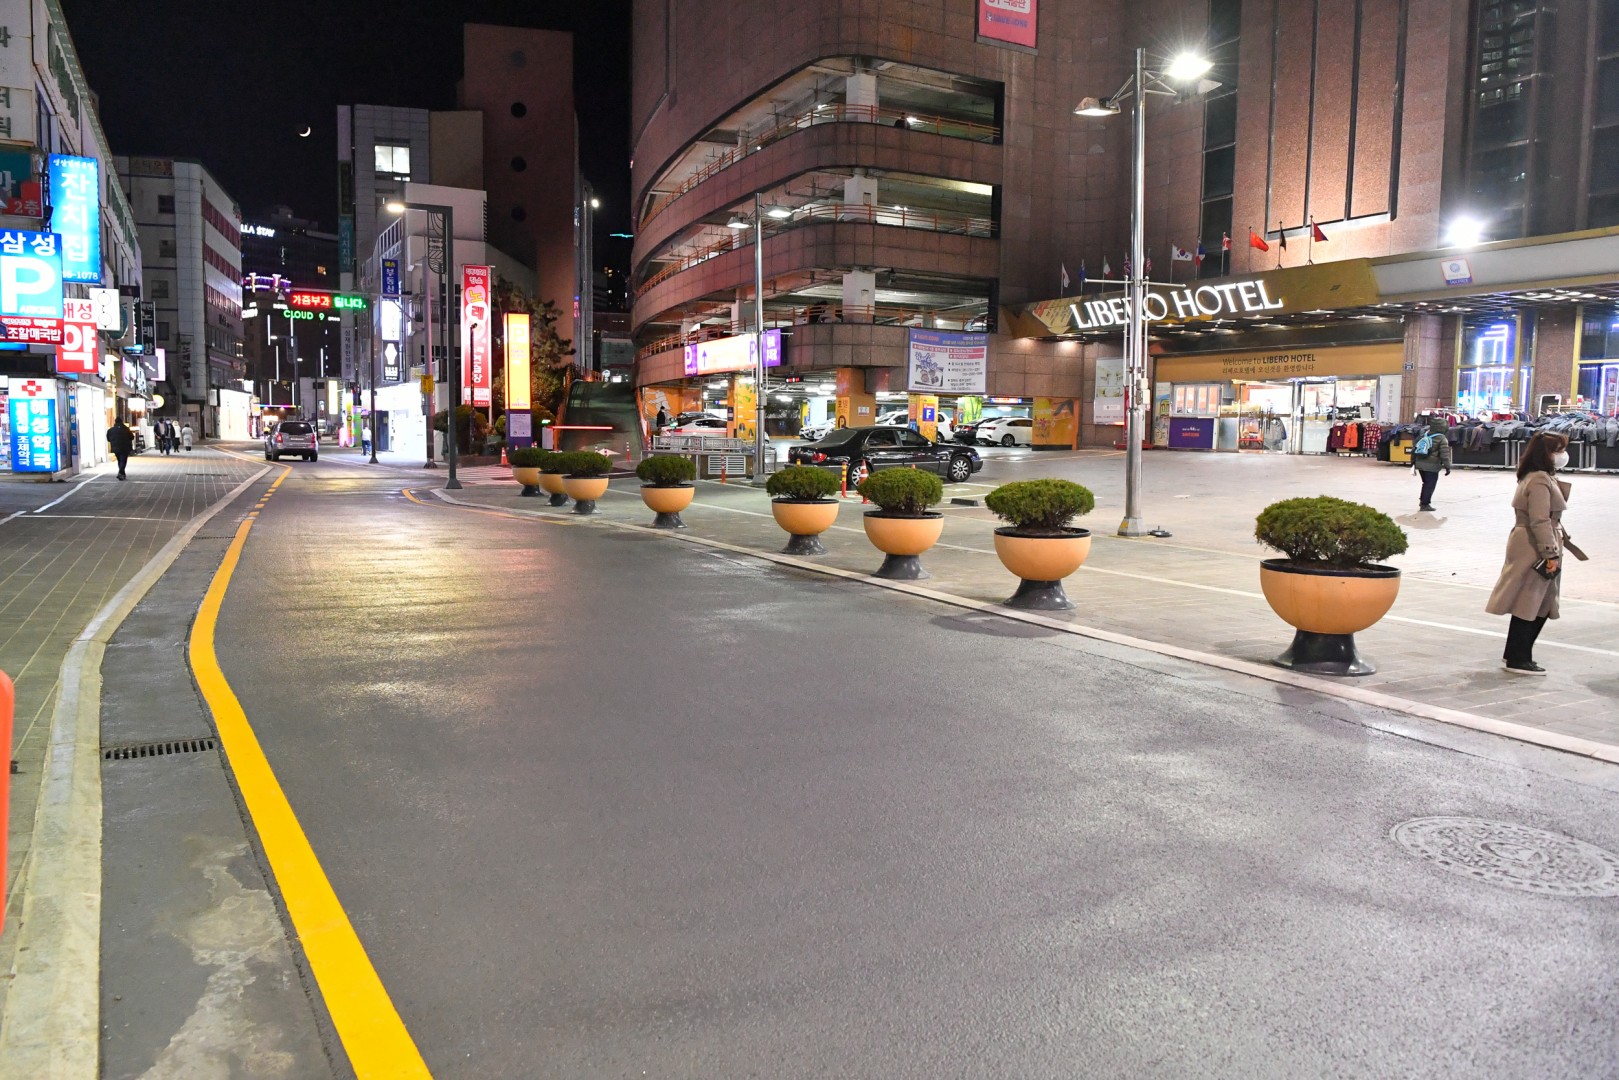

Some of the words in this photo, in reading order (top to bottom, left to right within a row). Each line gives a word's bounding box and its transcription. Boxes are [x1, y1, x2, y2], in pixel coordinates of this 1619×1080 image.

[14, 200, 39, 216] 2층
[61, 173, 91, 262] 잔치집
[0, 232, 57, 257] 삼성
[2, 255, 56, 314] P
[1170, 280, 1284, 320] HOTEL
[283, 309, 314, 320] CLOUD
[318, 312, 325, 321] 9
[60, 324, 97, 370] 약
[1223, 357, 1251, 366] Welcome
[1263, 355, 1289, 363] LIBERO
[1291, 354, 1315, 362] HOTEL
[1284, 364, 1314, 372] 환영합니다
[926, 409, 932, 419] F
